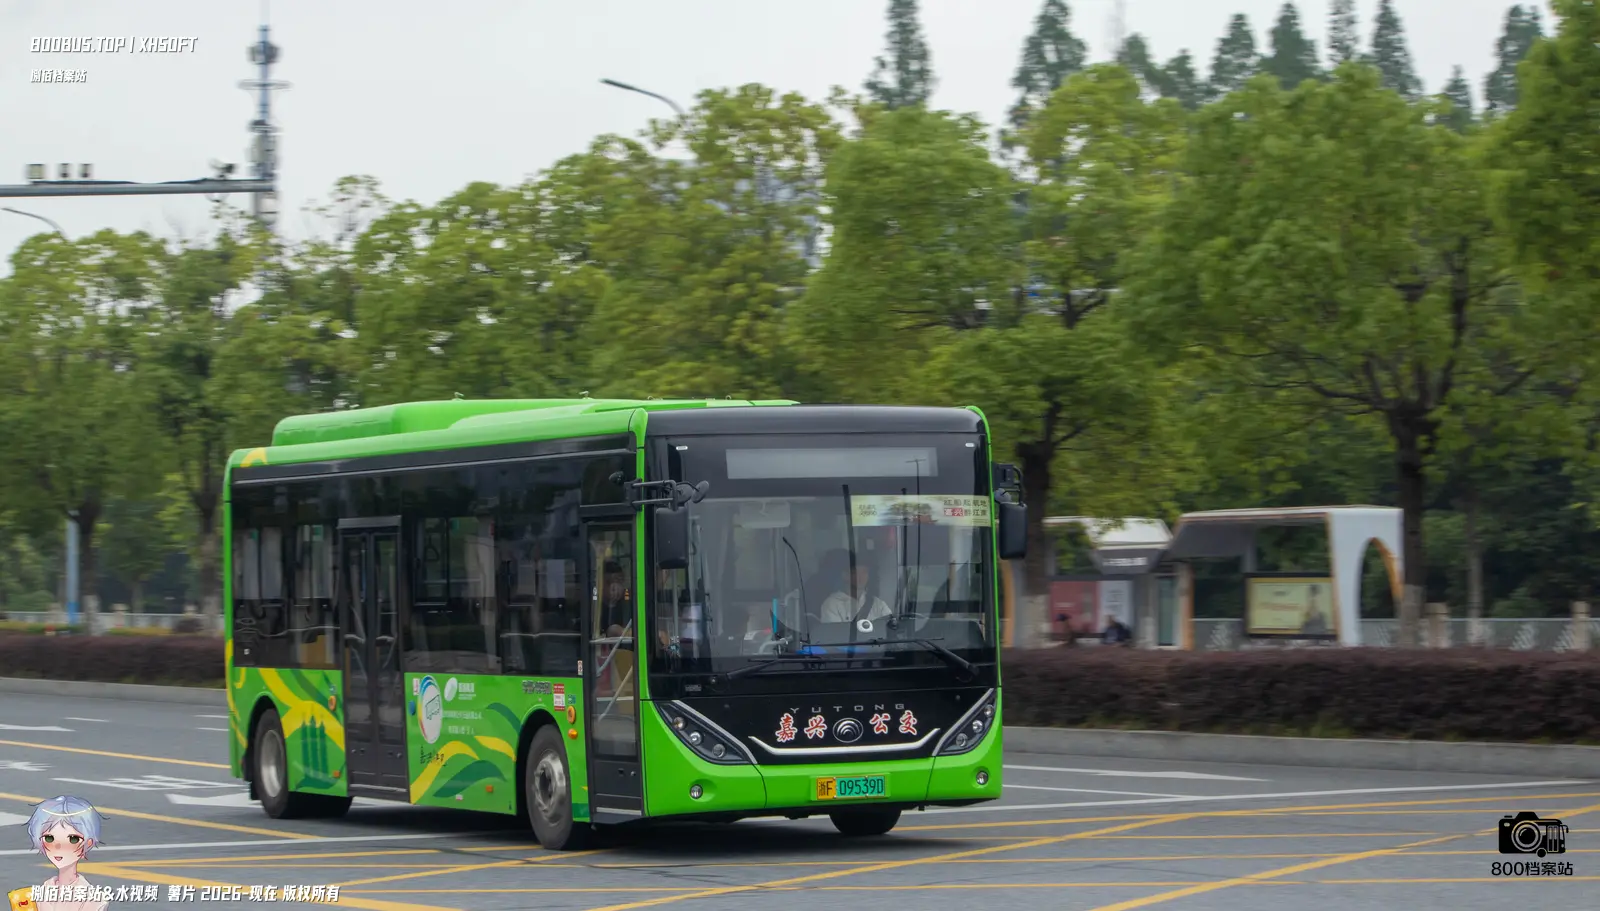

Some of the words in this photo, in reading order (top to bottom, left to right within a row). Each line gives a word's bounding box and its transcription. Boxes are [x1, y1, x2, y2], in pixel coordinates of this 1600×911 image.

[790, 704, 904, 714] YUTONG
[775, 713, 827, 743] 嘉兴
[869, 709, 917, 735] 公交
